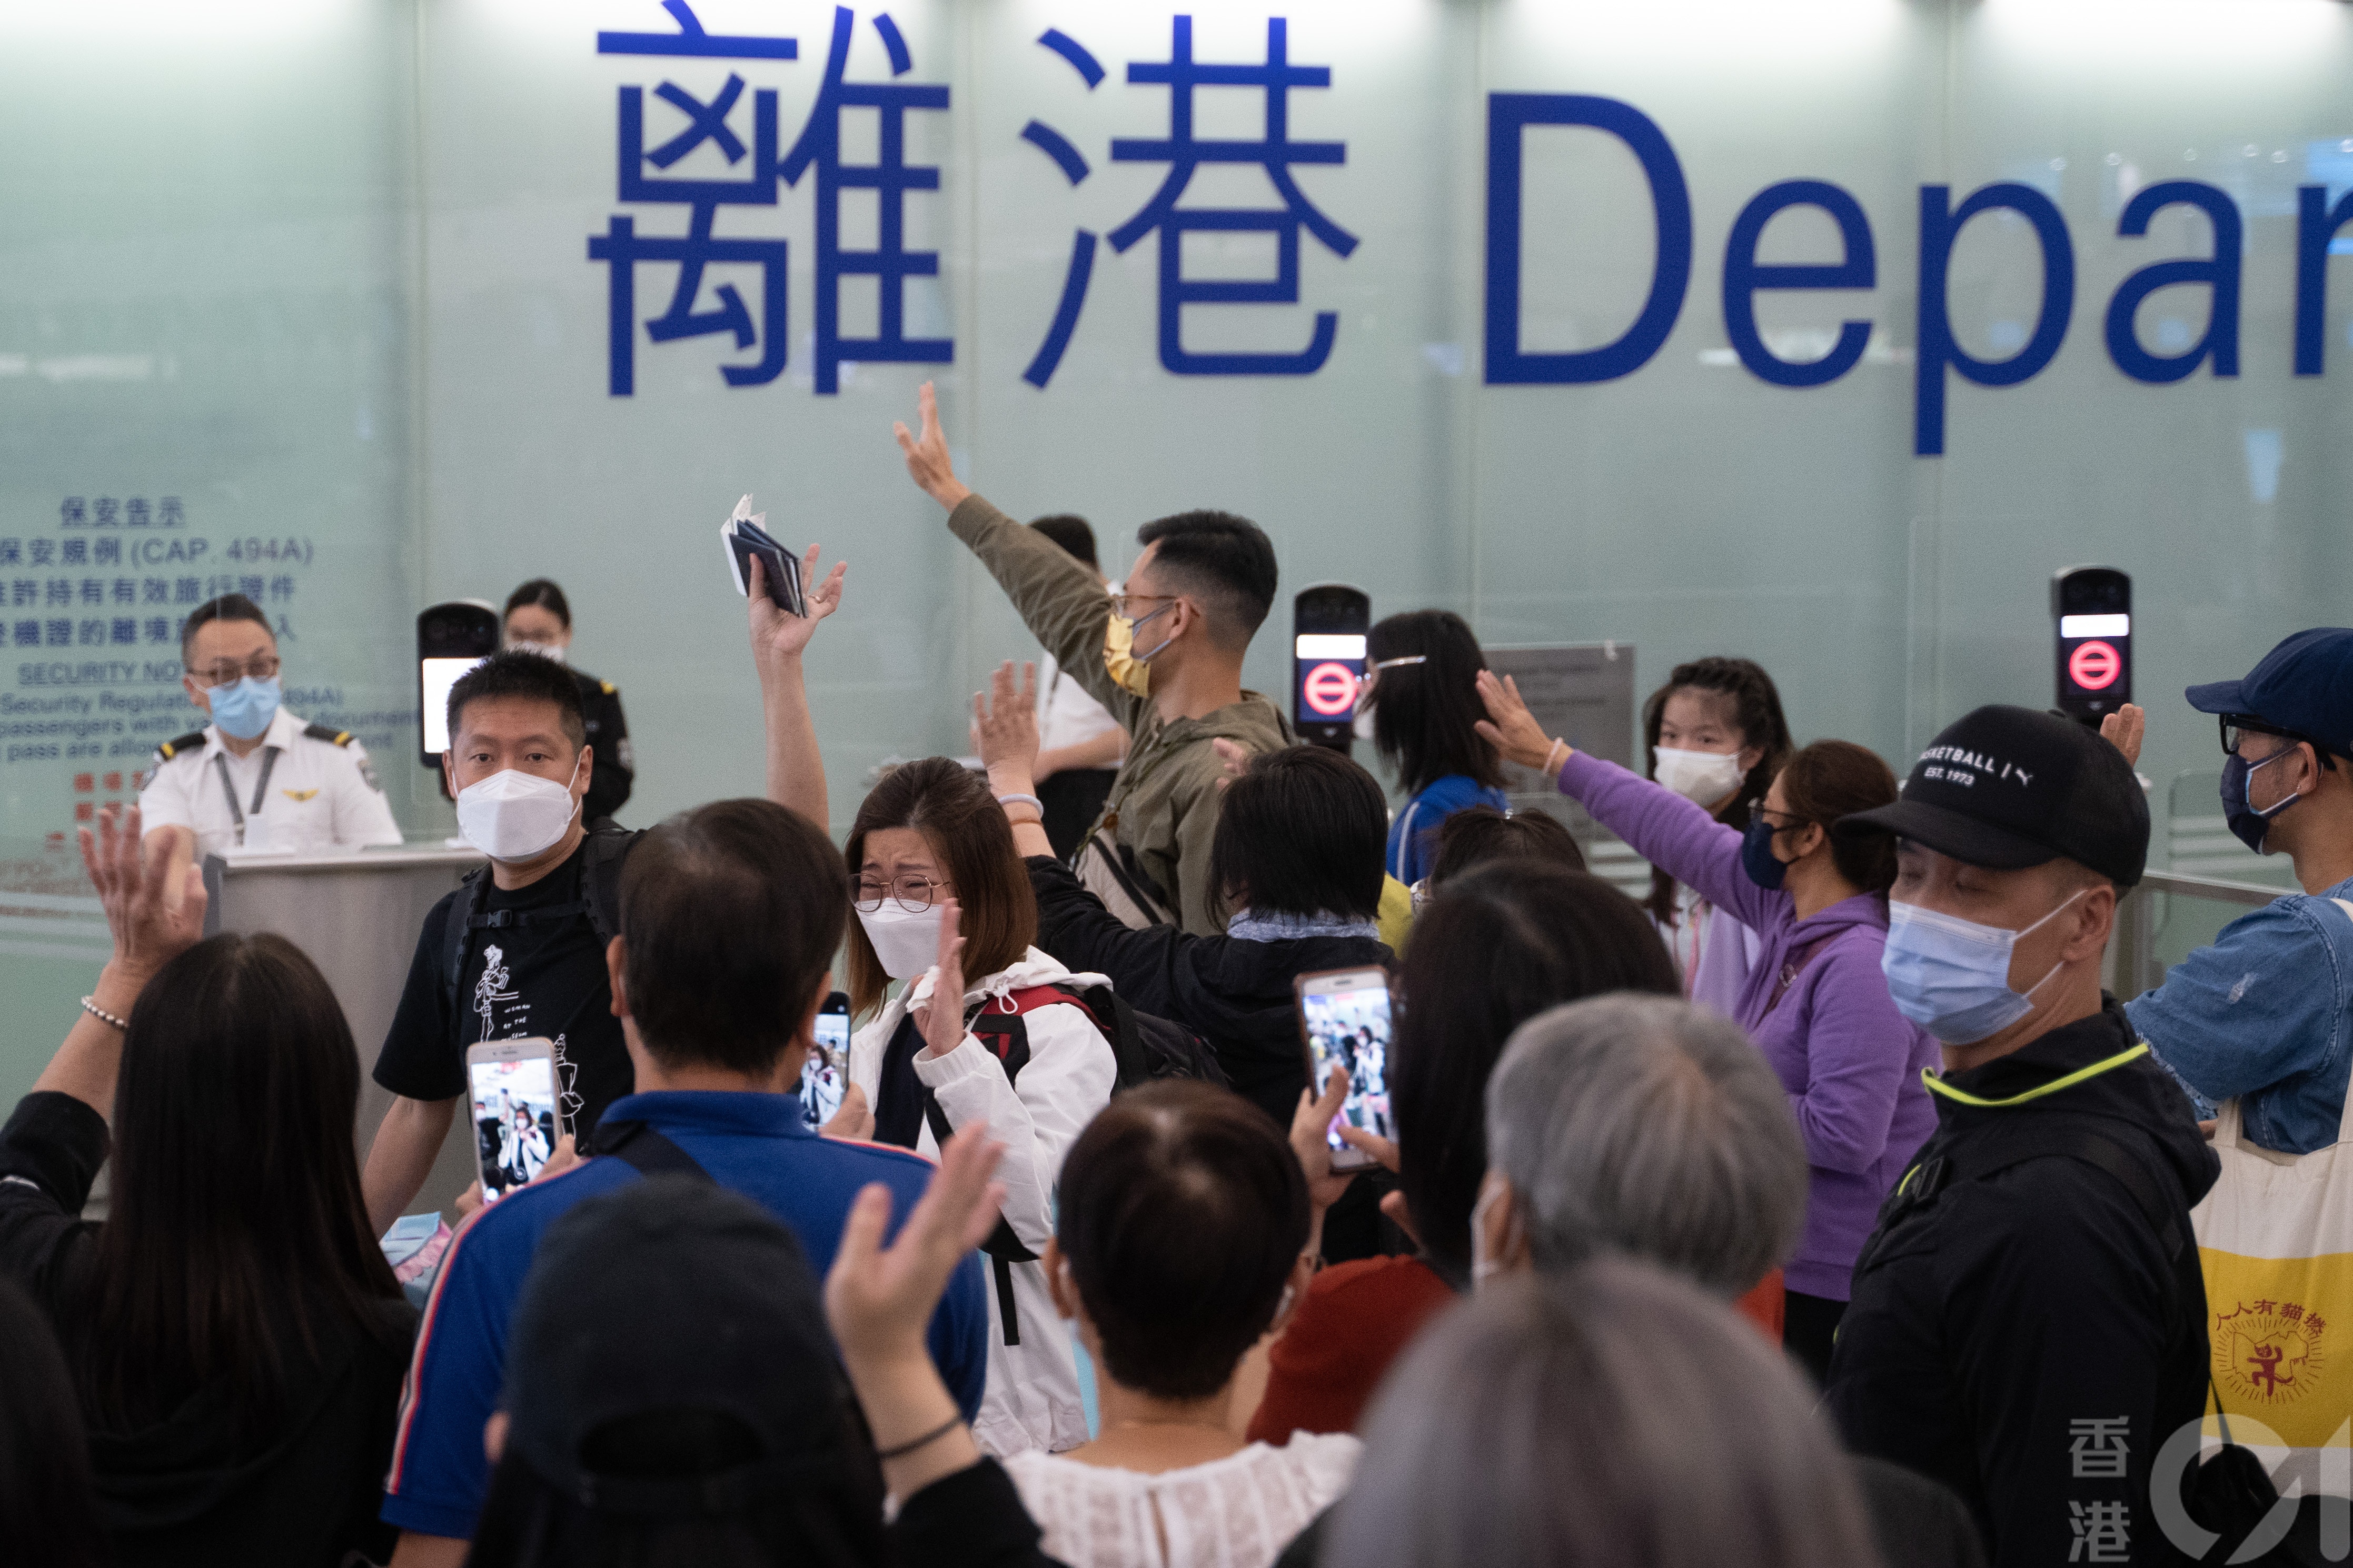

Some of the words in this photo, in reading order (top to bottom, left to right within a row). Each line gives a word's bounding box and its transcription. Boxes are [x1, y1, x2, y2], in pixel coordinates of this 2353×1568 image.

[587, 0, 1360, 397] 離港
[1482, 91, 2353, 457] Depar
[60, 496, 183, 526] 保安告示
[226, 536, 315, 568] 494A)
[18, 661, 137, 685] SECURITY
[1, 693, 92, 715] Security
[7, 743, 59, 762] pass
[66, 742, 103, 758] are
[1923, 767, 1944, 778] EST.
[1947, 770, 1975, 786] 1973
